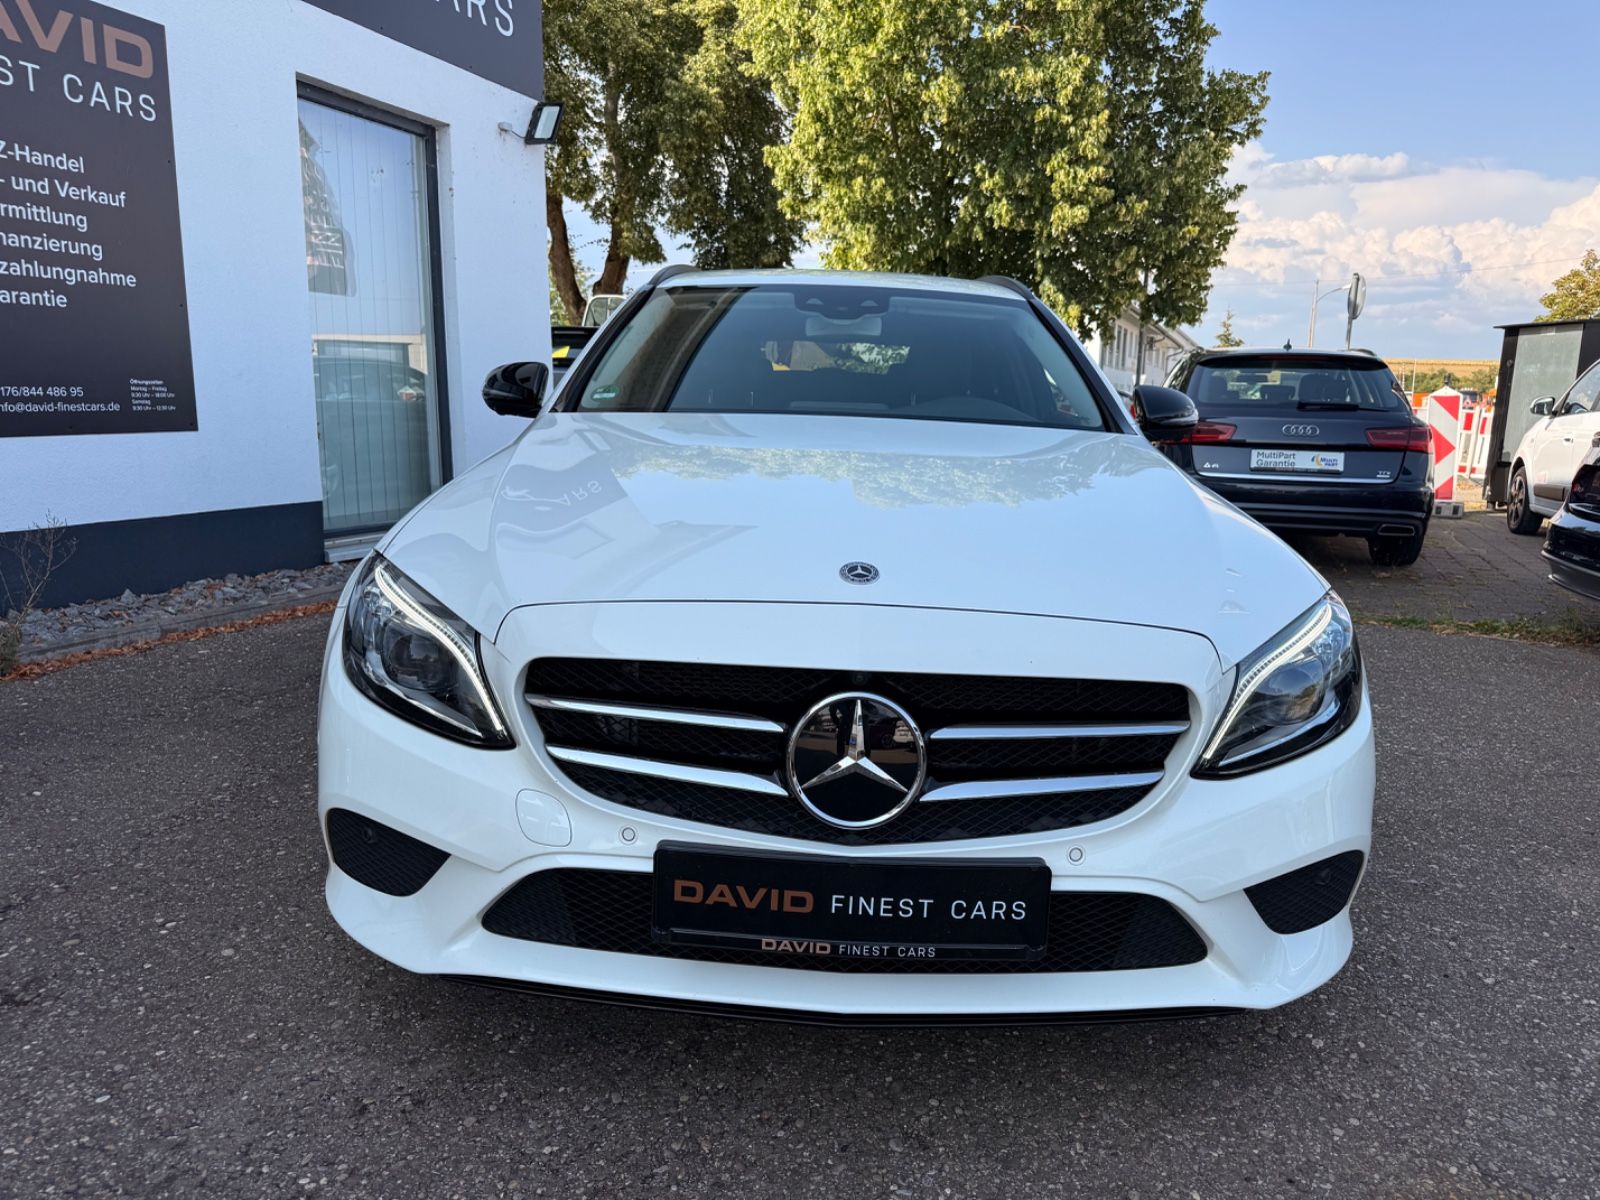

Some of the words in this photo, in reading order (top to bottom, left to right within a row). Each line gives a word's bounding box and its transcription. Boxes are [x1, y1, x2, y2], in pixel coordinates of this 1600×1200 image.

[62, 73, 157, 122] CARS
[11, 175, 50, 195] und
[54, 178, 126, 208] Verkauf
[0, 289, 67, 307] arantie
[46, 386, 67, 397] 486
[70, 386, 84, 397] 95
[1256, 451, 1296, 460] MultiPart
[1256, 459, 1296, 467] Garantie
[673, 879, 815, 914] DAVID
[831, 895, 934, 919] FINEST
[950, 900, 1027, 921] CARS
[761, 938, 831, 955] DAVID
[838, 944, 890, 957] FINEST
[897, 946, 936, 958] CARS
